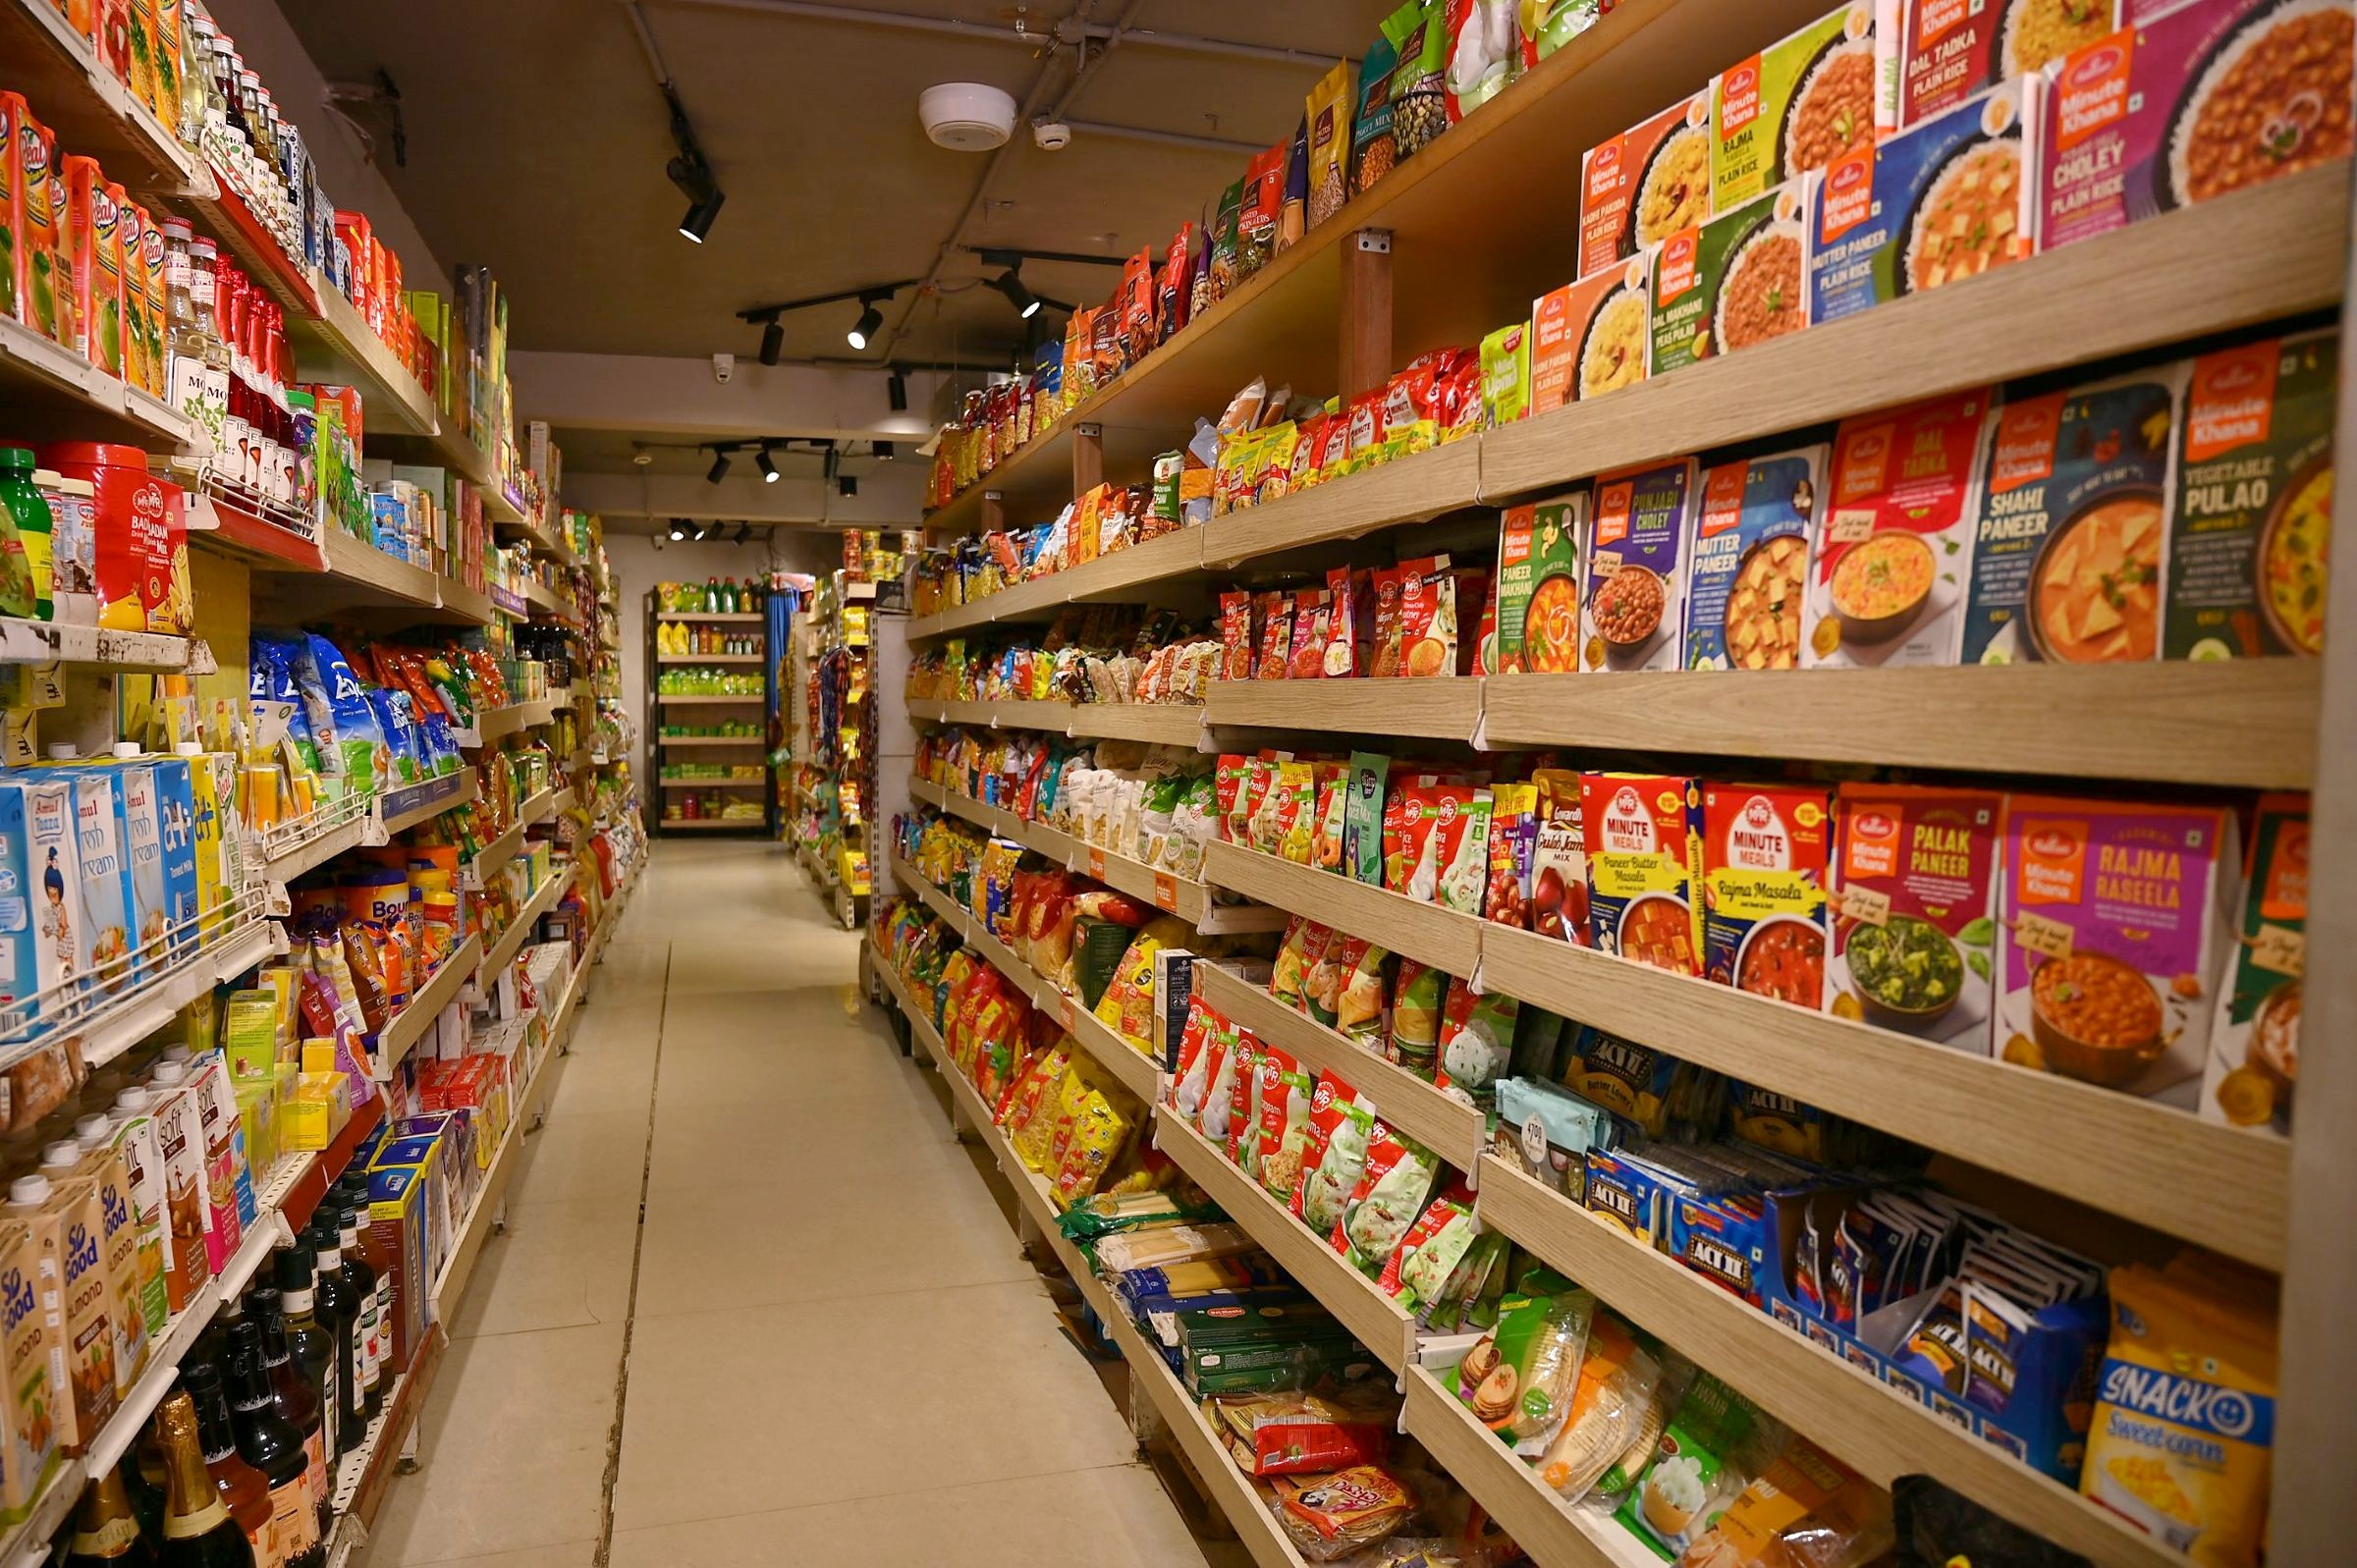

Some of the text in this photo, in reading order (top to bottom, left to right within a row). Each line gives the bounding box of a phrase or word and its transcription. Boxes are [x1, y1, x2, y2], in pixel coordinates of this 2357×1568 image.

[1909, 28, 1976, 78] DAL TADKA
[1913, 58, 1969, 97] PLAIN RICE
[1722, 89, 1757, 118] Minute
[1374, 113, 1392, 130] MIX
[1723, 105, 1755, 131] Khana
[1723, 130, 1754, 156] RAJMA
[1719, 157, 1759, 187] PLAIN RICE
[2053, 138, 2125, 189] CHOLEY
[1590, 164, 1619, 187] Minute
[1591, 177, 1617, 197] Khana
[1824, 185, 1869, 214] Minute
[2051, 174, 2125, 216] PLAIN RICE
[1825, 205, 1866, 232] Khana
[1586, 224, 1604, 243] PLAIN
[1847, 229, 1887, 259] PANEER
[1660, 260, 1695, 282] Minute
[1820, 258, 1873, 292] PLAIN RICE
[1661, 276, 1691, 297] Khana
[1540, 316, 1564, 332] Minute
[1485, 372, 1517, 399] Upma
[1384, 407, 1393, 425] 3
[1914, 428, 1946, 454] DAL
[1903, 453, 1948, 478] TADKA
[2185, 455, 2275, 488] VEGETABLE
[148, 492, 161, 509] MTR
[1632, 493, 1679, 513] PUNJABI
[1990, 487, 2046, 517] SHAHI
[2185, 479, 2270, 516] PULAO
[1636, 512, 1669, 531] CHOLEY
[1704, 511, 1737, 526] Khana
[1979, 512, 2049, 541] PANEER
[156, 540, 168, 556] Mix
[1505, 534, 1532, 547] Minute
[1506, 545, 1529, 558] Khana
[1696, 533, 1741, 556] MUTTER
[1503, 565, 1532, 582] PANEER
[1694, 554, 1738, 576] PANEER
[1500, 579, 1533, 598] MAKHANI
[35, 798, 59, 816] Amul
[1438, 804, 1453, 819] MTR
[82, 823, 105, 851] resh
[1607, 818, 1649, 838] MINUTE
[1913, 824, 1971, 854] PALAK
[133, 841, 159, 865] ream
[1613, 837, 1643, 851] MEALS
[1732, 831, 1783, 854] MINUTE
[1851, 841, 1891, 860] Minute
[82, 854, 116, 879] ream
[1553, 853, 1570, 862] MIX
[1604, 855, 1659, 870] Paneer Butter
[1739, 849, 1776, 868] MEALS
[1909, 850, 1970, 878] PANEER
[2099, 843, 2182, 882] RAJMA
[1615, 870, 1646, 884] Masala
[2024, 862, 2075, 884] Minute
[1718, 880, 1803, 901] Rajma Masala
[2095, 875, 2181, 909] RASEELA
[1593, 1039, 1624, 1068] ACT
[1313, 1087, 1330, 1107] MTR
[1587, 1080, 1612, 1093] Butter
[160, 1107, 183, 1149] sofit
[1594, 1183, 1631, 1216] ACT II
[65, 1235, 98, 1288] Good
[1694, 1241, 1743, 1279] ACT II
[2107, 1410, 2225, 1463] Sweet corn
